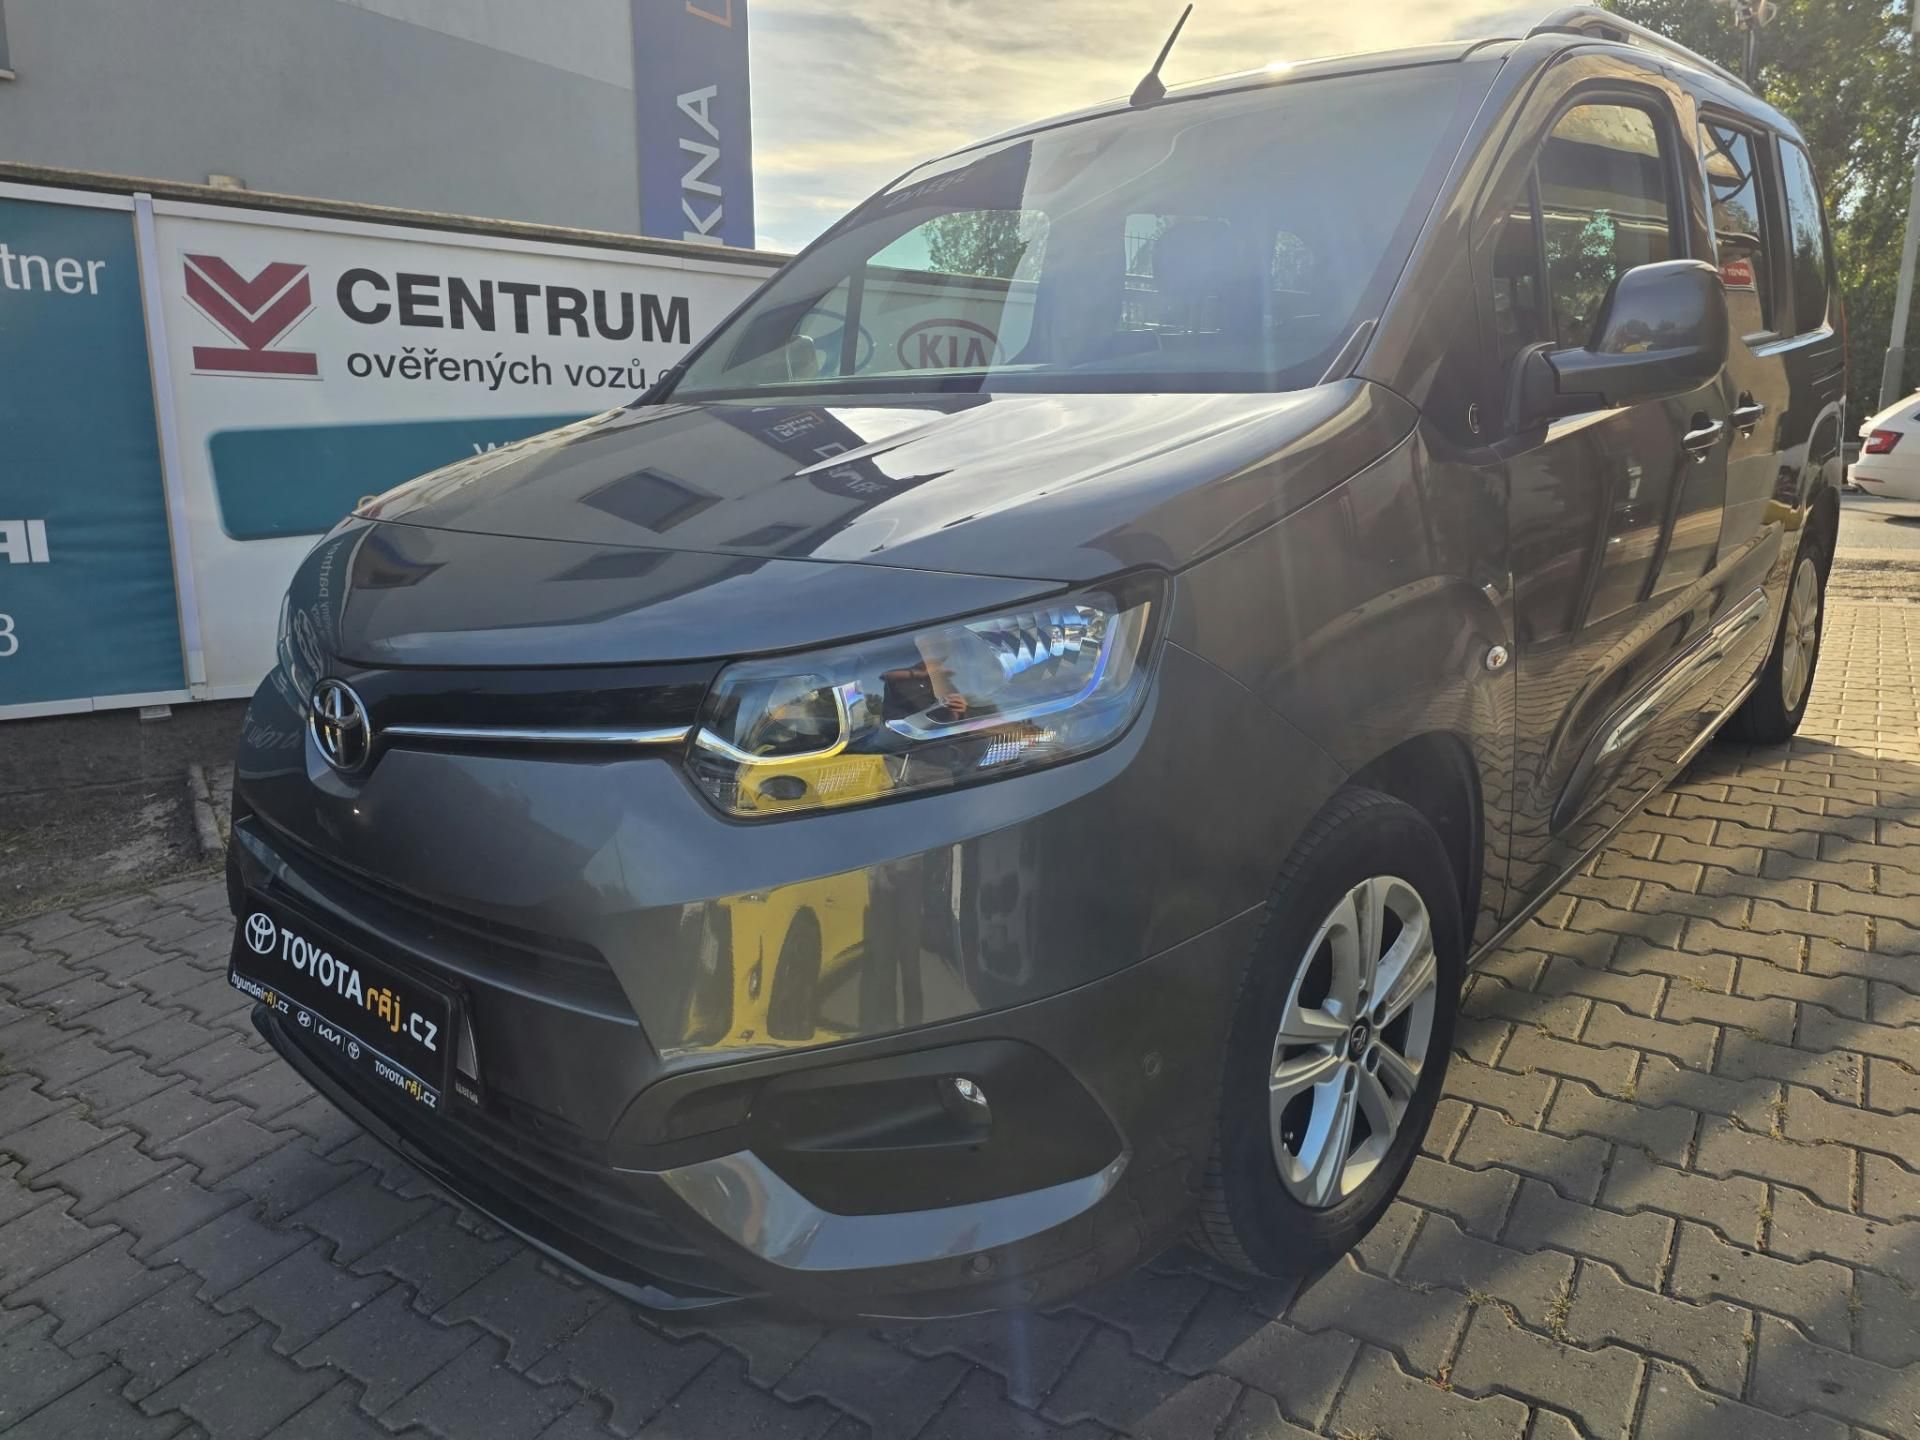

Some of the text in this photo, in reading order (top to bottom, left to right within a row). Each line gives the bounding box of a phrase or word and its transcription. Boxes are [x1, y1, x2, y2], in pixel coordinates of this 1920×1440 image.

[336, 267, 692, 345] CENTRUM
[347, 346, 553, 392] ověřených
[917, 333, 988, 369] KIA
